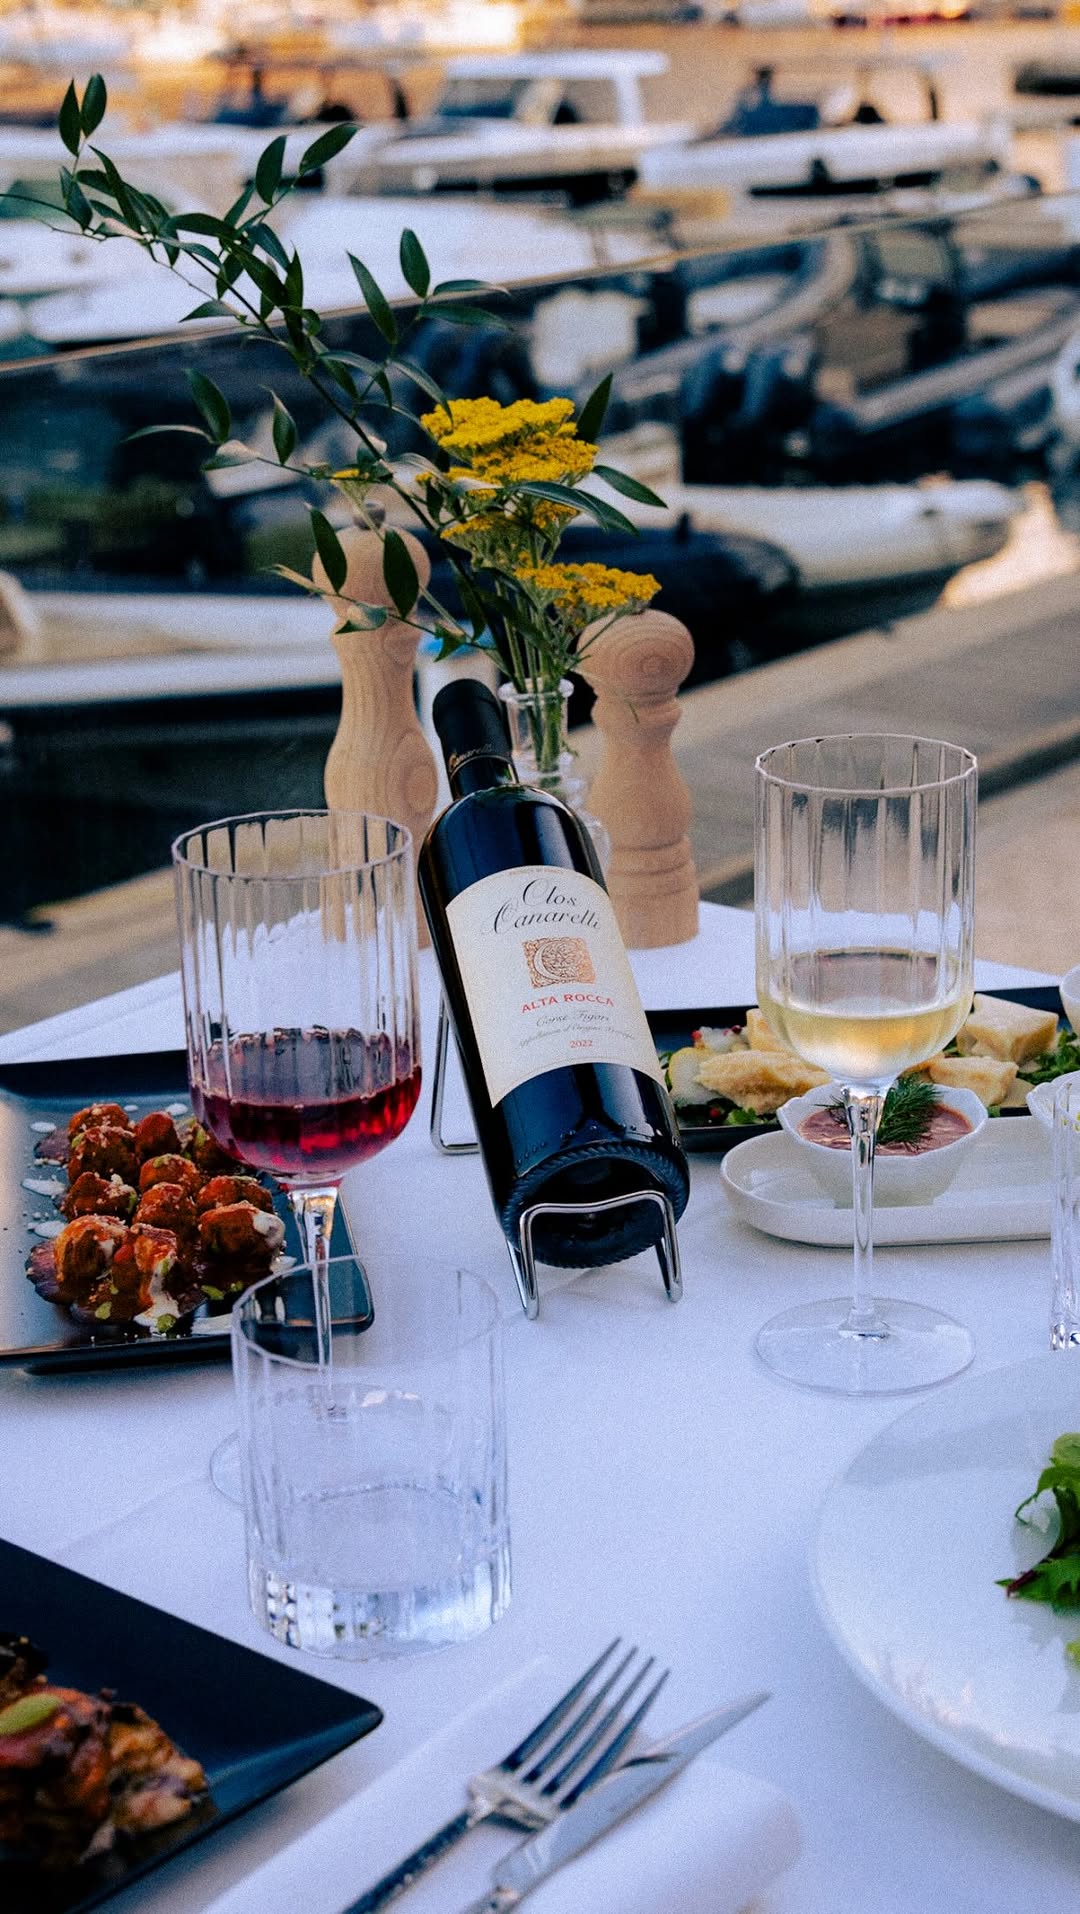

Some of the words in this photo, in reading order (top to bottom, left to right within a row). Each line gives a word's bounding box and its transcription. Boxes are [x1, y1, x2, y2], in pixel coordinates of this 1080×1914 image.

[522, 878, 577, 906] Clos
[483, 899, 601, 934] Canarelli
[522, 995, 558, 1013] ALTA
[563, 993, 615, 1007] ROCCA
[570, 1040, 593, 1048] 2022
